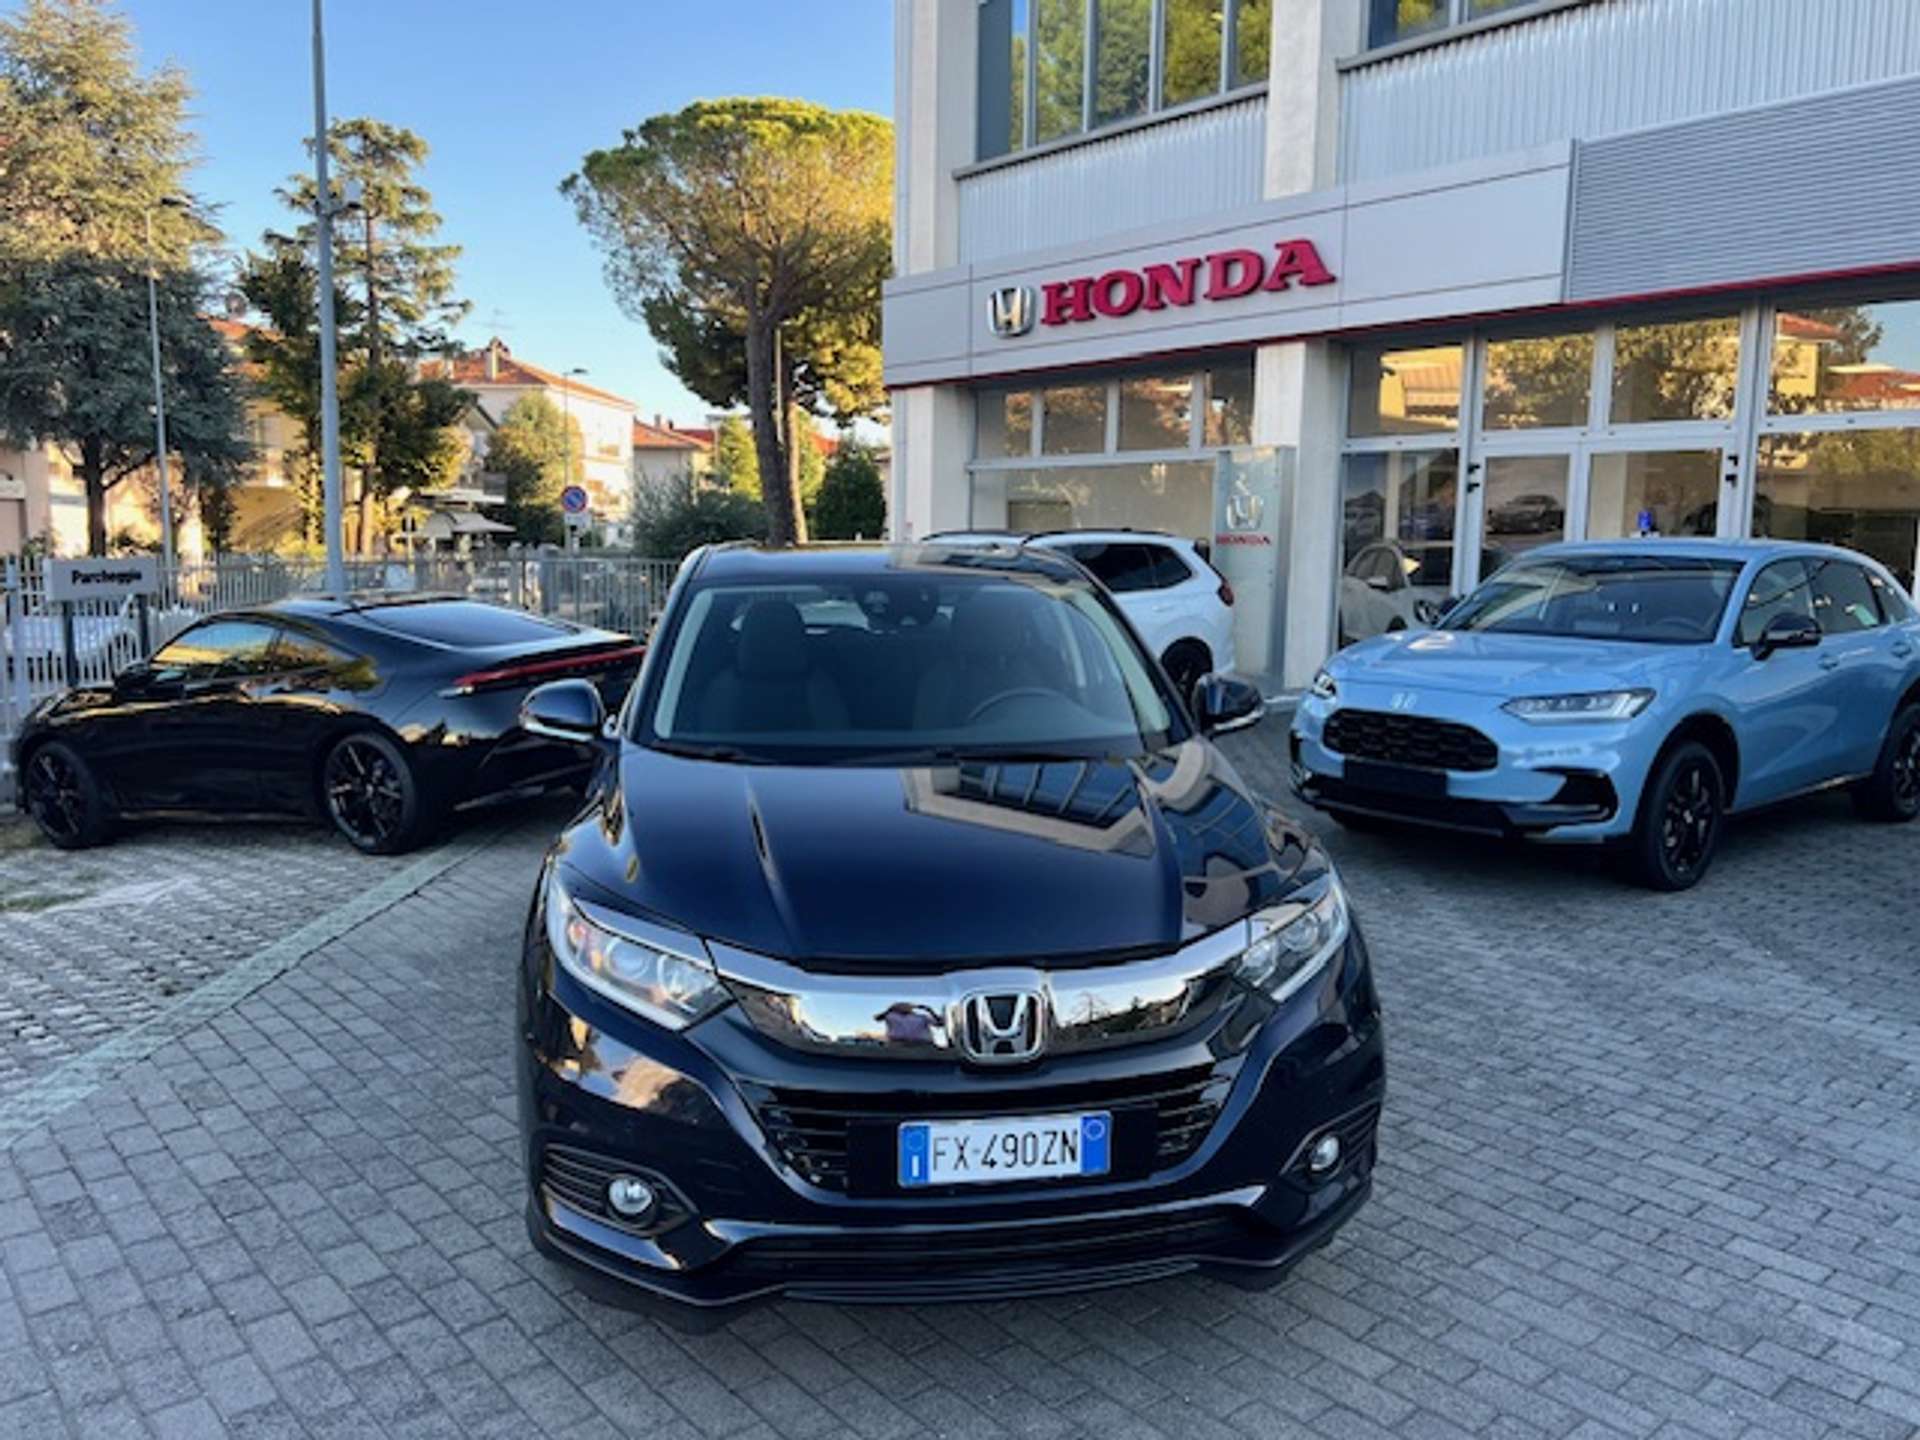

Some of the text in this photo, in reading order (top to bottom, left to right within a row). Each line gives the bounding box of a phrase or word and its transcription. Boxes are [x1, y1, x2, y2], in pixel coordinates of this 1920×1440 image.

[1041, 239, 1336, 326] HONDA
[1215, 534, 1271, 546] HONDA
[71, 569, 142, 585] Parcheggio
